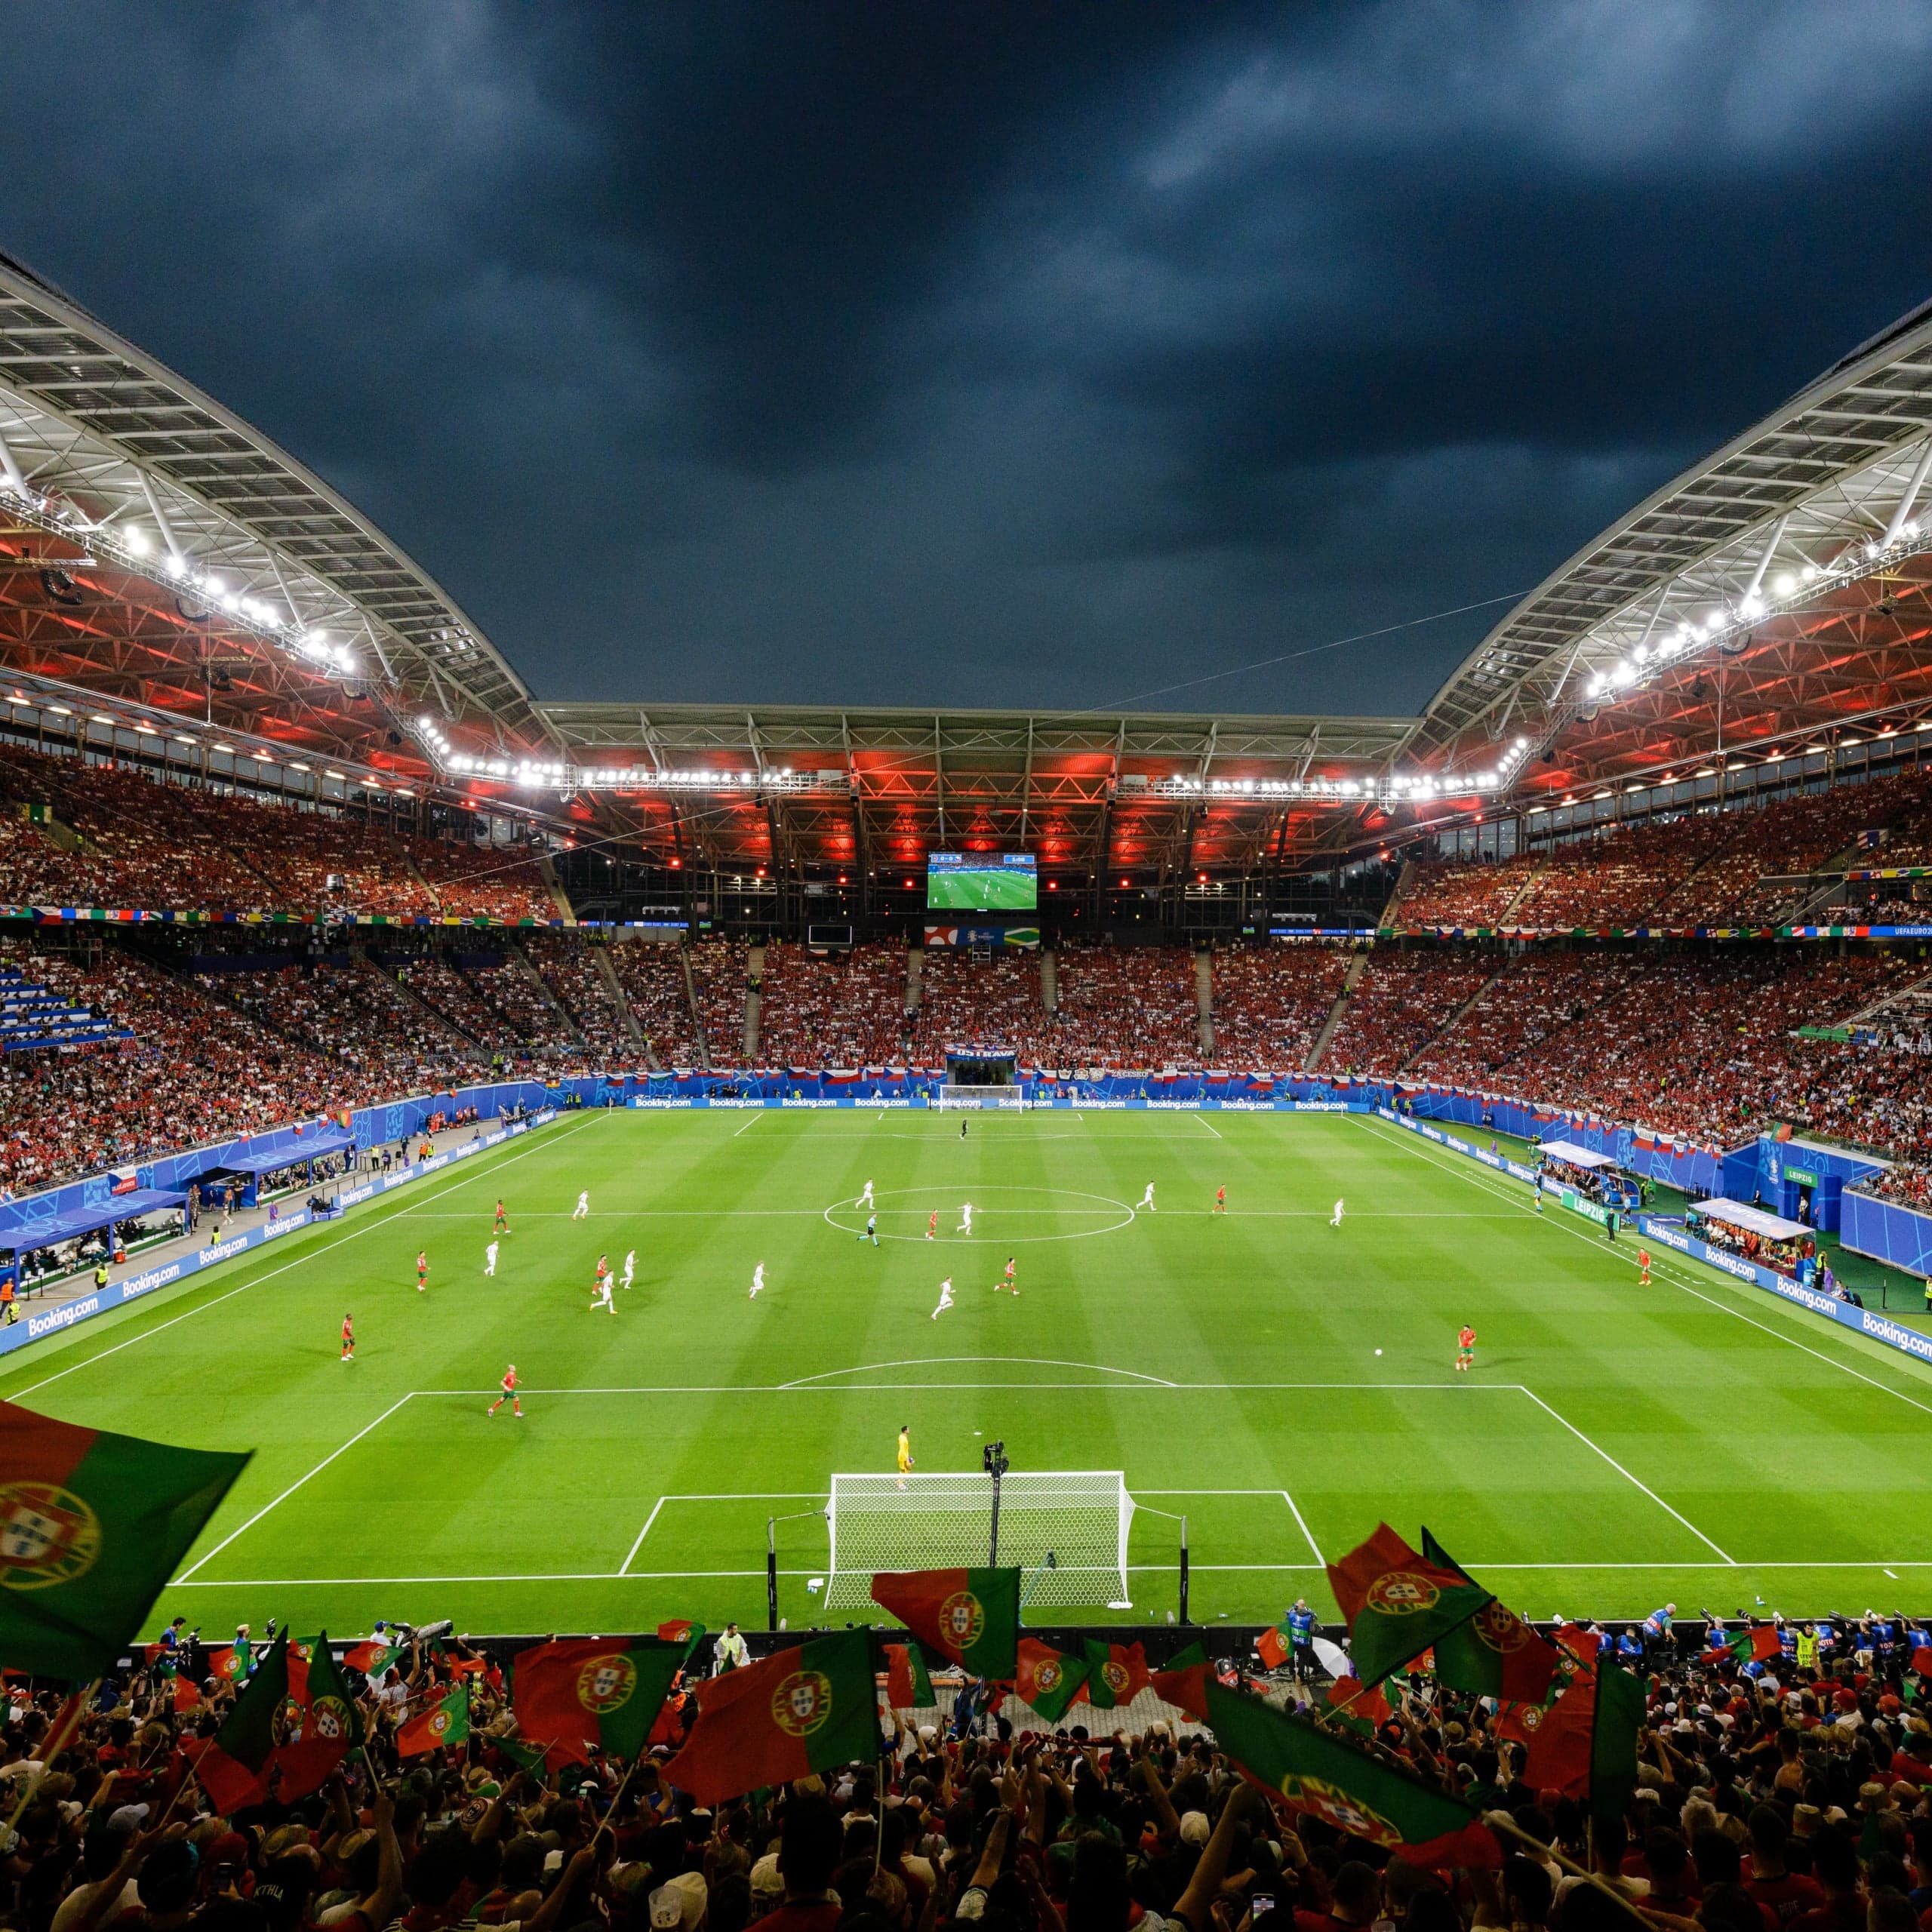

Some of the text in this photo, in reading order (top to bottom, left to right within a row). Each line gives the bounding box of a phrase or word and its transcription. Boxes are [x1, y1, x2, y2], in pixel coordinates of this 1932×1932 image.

[957, 1049, 1015, 1057] OSTRAVA
[636, 1098, 691, 1109] Booking.com
[709, 1098, 764, 1109] Booking.com
[782, 1098, 837, 1109] Booking.com
[855, 1098, 909, 1109] Booking.com
[998, 1098, 1053, 1109] Bookng.com
[1072, 1099, 1126, 1109] Booking.com
[1147, 1100, 1201, 1109] Booking.com
[1222, 1100, 1275, 1111] Booking.com
[1296, 1101, 1348, 1112] Booking.com
[423, 1155, 448, 1171] Booking.com
[1476, 1147, 1500, 1166] Booking.com
[384, 1169, 414, 1188] Booking.com
[1508, 1161, 1535, 1181] Booking.com
[1789, 1171, 1812, 1183] LEIPZIG
[340, 1186, 373, 1207] Booking.com
[1574, 1197, 1605, 1222] LEIPZIG
[264, 1213, 305, 1238] Booking.com
[1646, 1220, 1688, 1251] Booking.com
[199, 1235, 248, 1265] Booking.com
[1706, 1245, 1755, 1280] Booking.com
[123, 1263, 180, 1298] Booking.com
[1777, 1275, 1836, 1315] Booking.com
[29, 1297, 98, 1337] Booking.com
